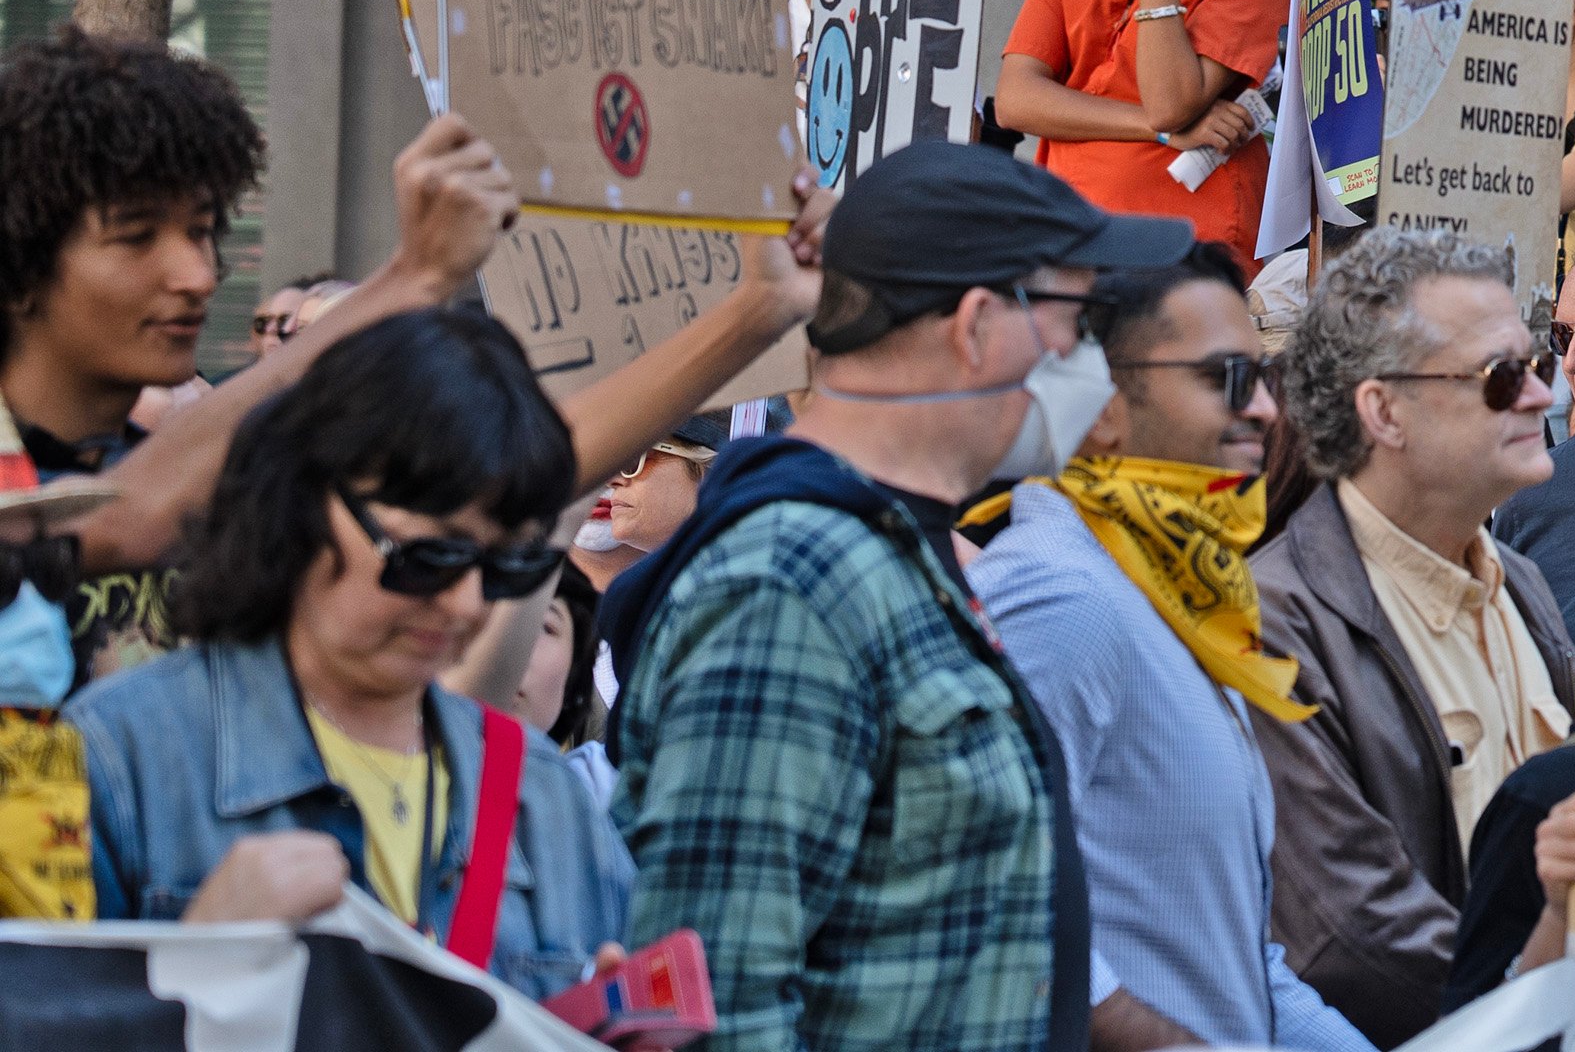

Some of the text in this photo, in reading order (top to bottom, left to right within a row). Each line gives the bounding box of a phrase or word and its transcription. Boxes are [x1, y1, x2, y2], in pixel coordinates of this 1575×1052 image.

[1467, 7, 1568, 45] AMERICA IS
[1301, 15, 1332, 125] PROP
[1334, 0, 1368, 104] 50
[1464, 57, 1518, 87] BEING
[1460, 104, 1563, 141] MURDERED!
[1343, 180, 1365, 194] LEARN
[1346, 170, 1363, 183] SCAN
[1392, 153, 1534, 197] Let's get back to
